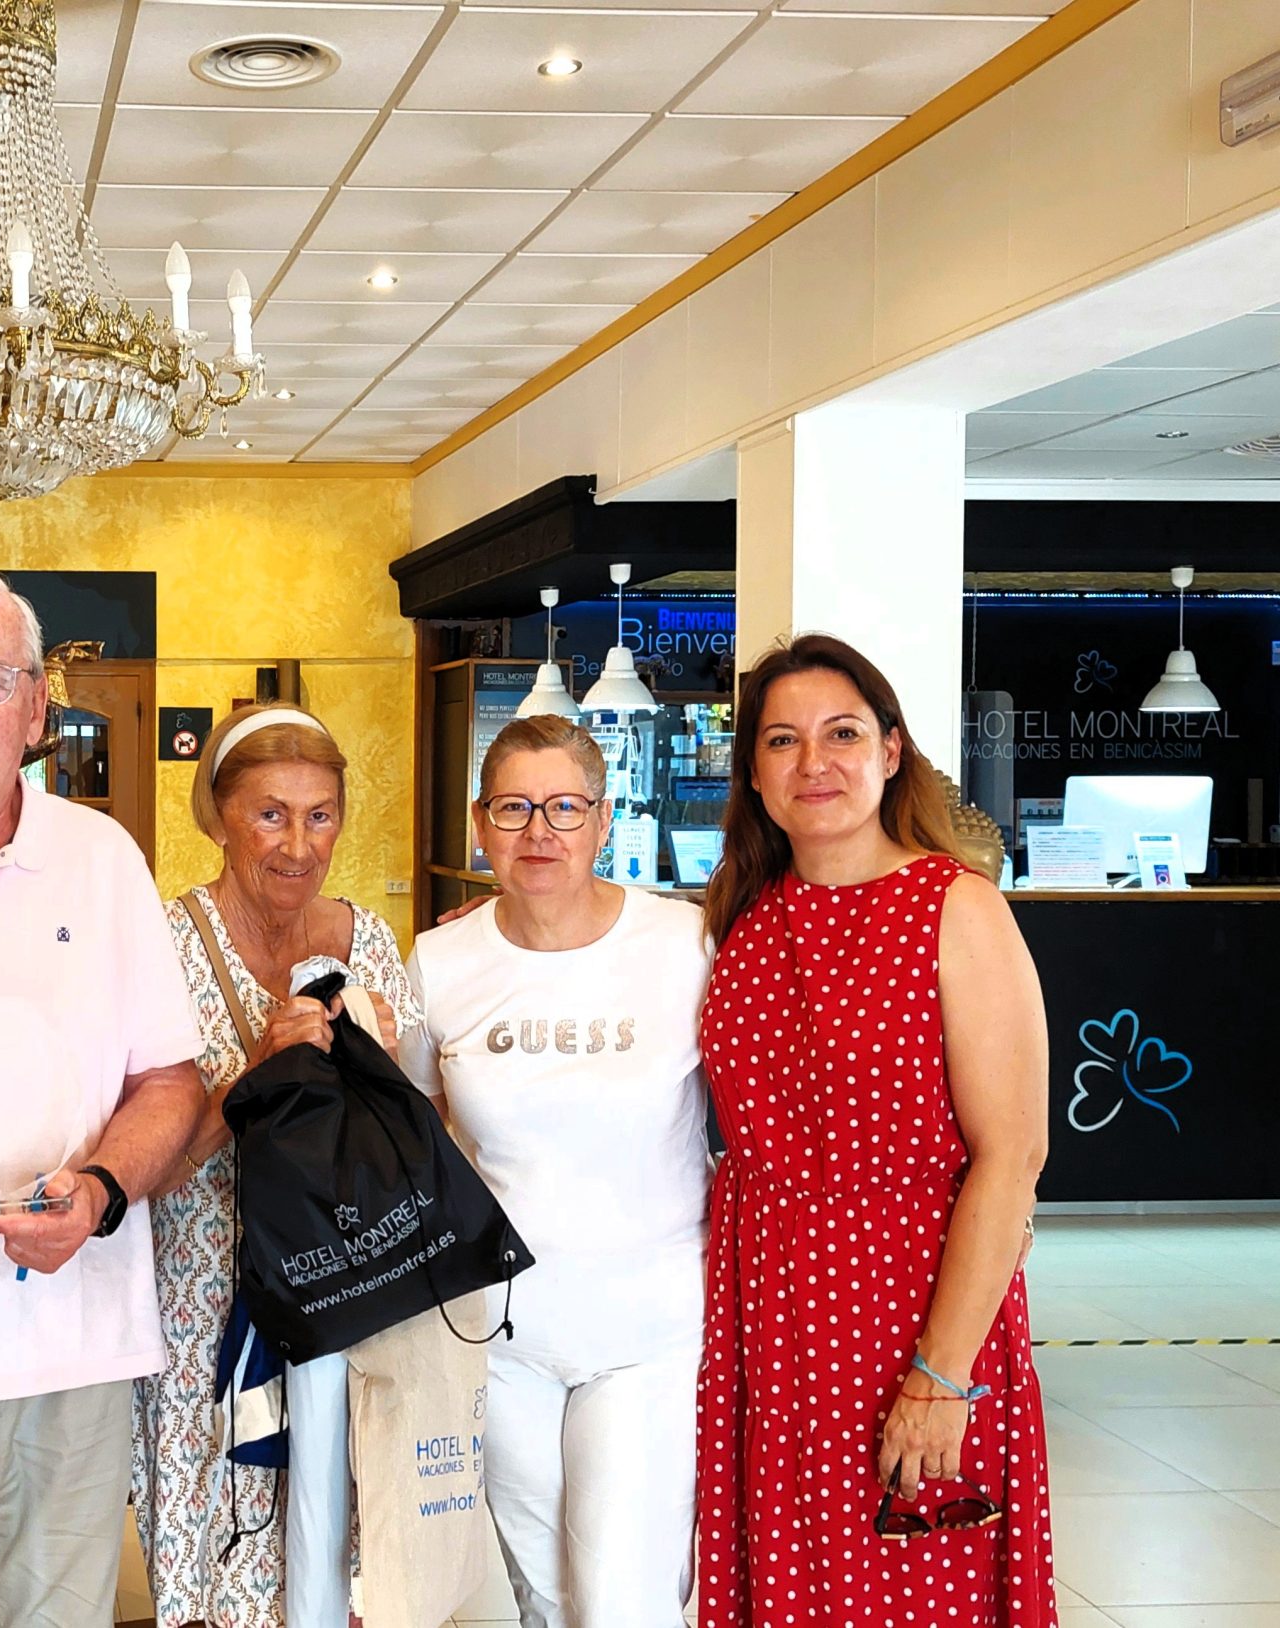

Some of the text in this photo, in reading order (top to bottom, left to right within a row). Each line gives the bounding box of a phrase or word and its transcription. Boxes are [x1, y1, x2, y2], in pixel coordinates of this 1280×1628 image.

[483, 673, 505, 681] HOTEL
[962, 710, 1241, 739] HOTEL MONTREAL
[962, 740, 1202, 759] VACACIONES EN BENICÀSSIM
[487, 1018, 635, 1054] GUESS
[281, 1190, 434, 1276] HOTEL MONTREAL
[288, 1260, 349, 1287] VACACIONES
[352, 1253, 368, 1267] EN
[300, 1230, 456, 1316] www.hotelmontreal.es
[417, 1436, 465, 1461] HOTEL
[417, 1460, 465, 1478] VACACIONES
